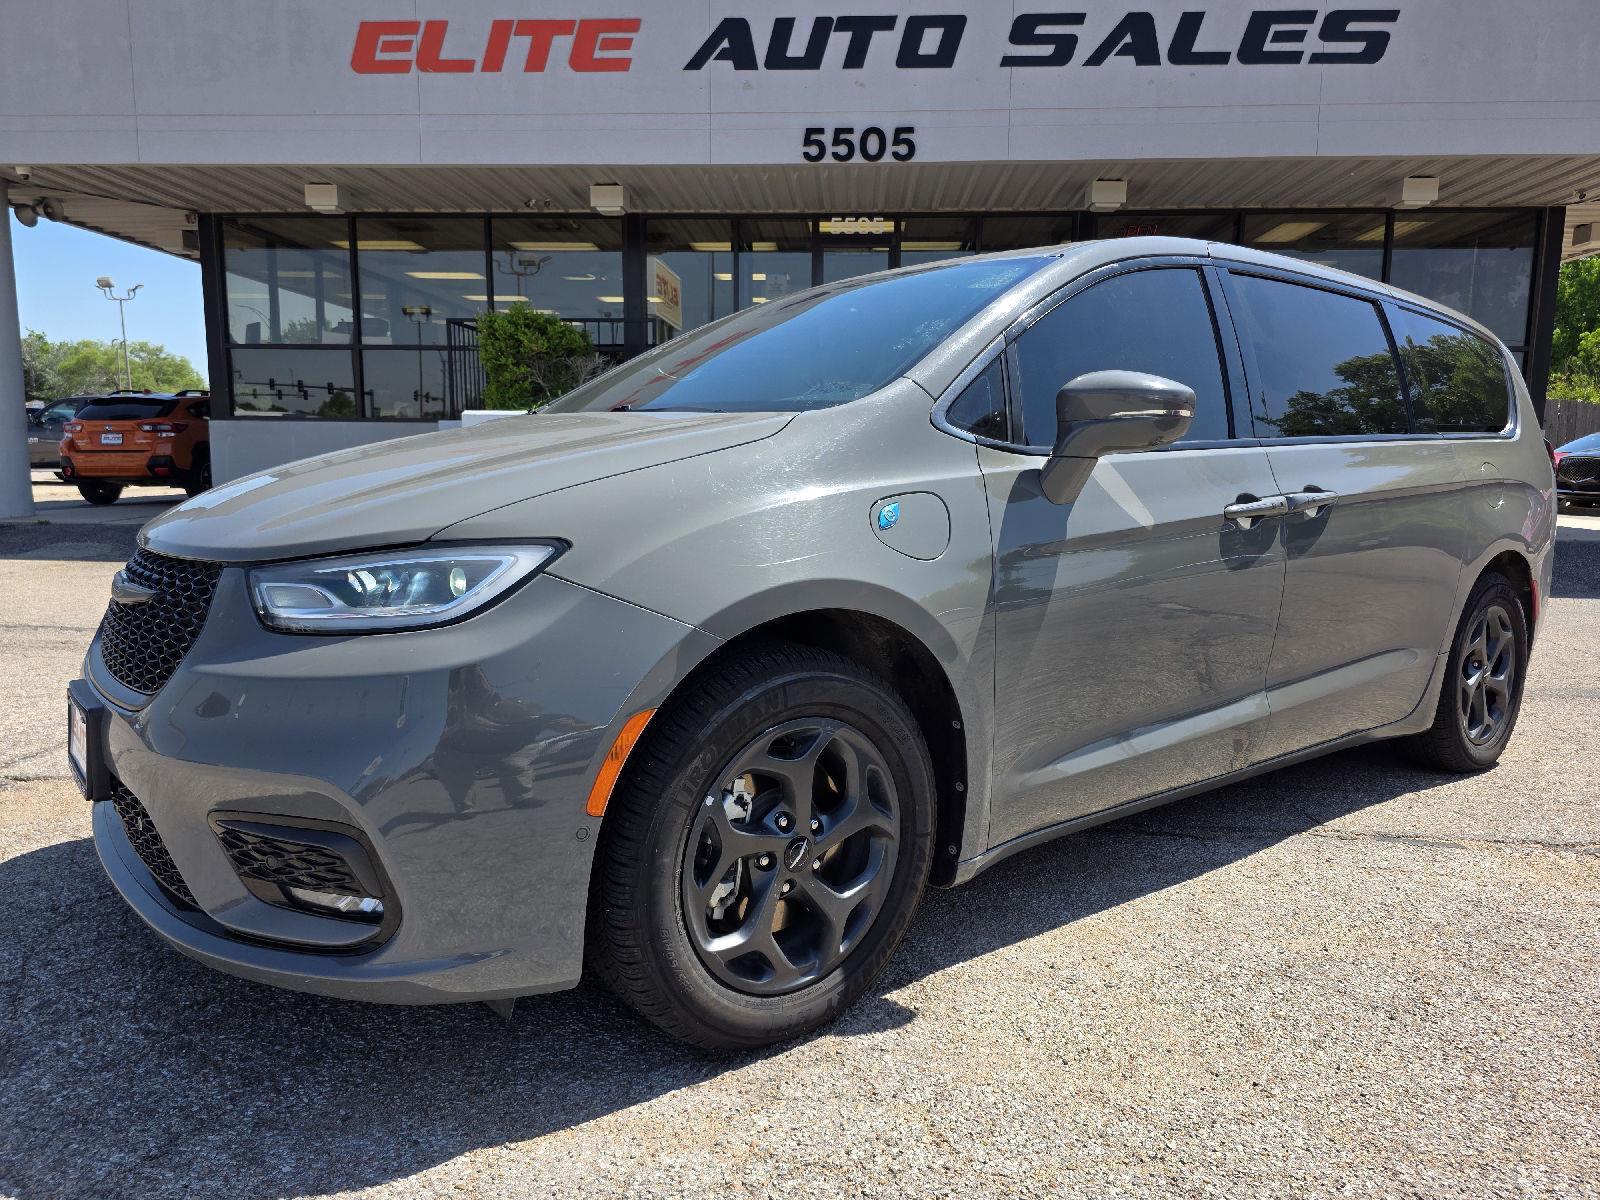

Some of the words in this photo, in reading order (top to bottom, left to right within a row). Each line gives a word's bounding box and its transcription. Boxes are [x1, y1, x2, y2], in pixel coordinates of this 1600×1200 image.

[351, 18, 642, 74] ELITE
[683, 14, 967, 70] AUTO
[1000, 9, 1400, 67] SALES
[802, 126, 916, 162] 5505
[831, 217, 884, 234] 5505
